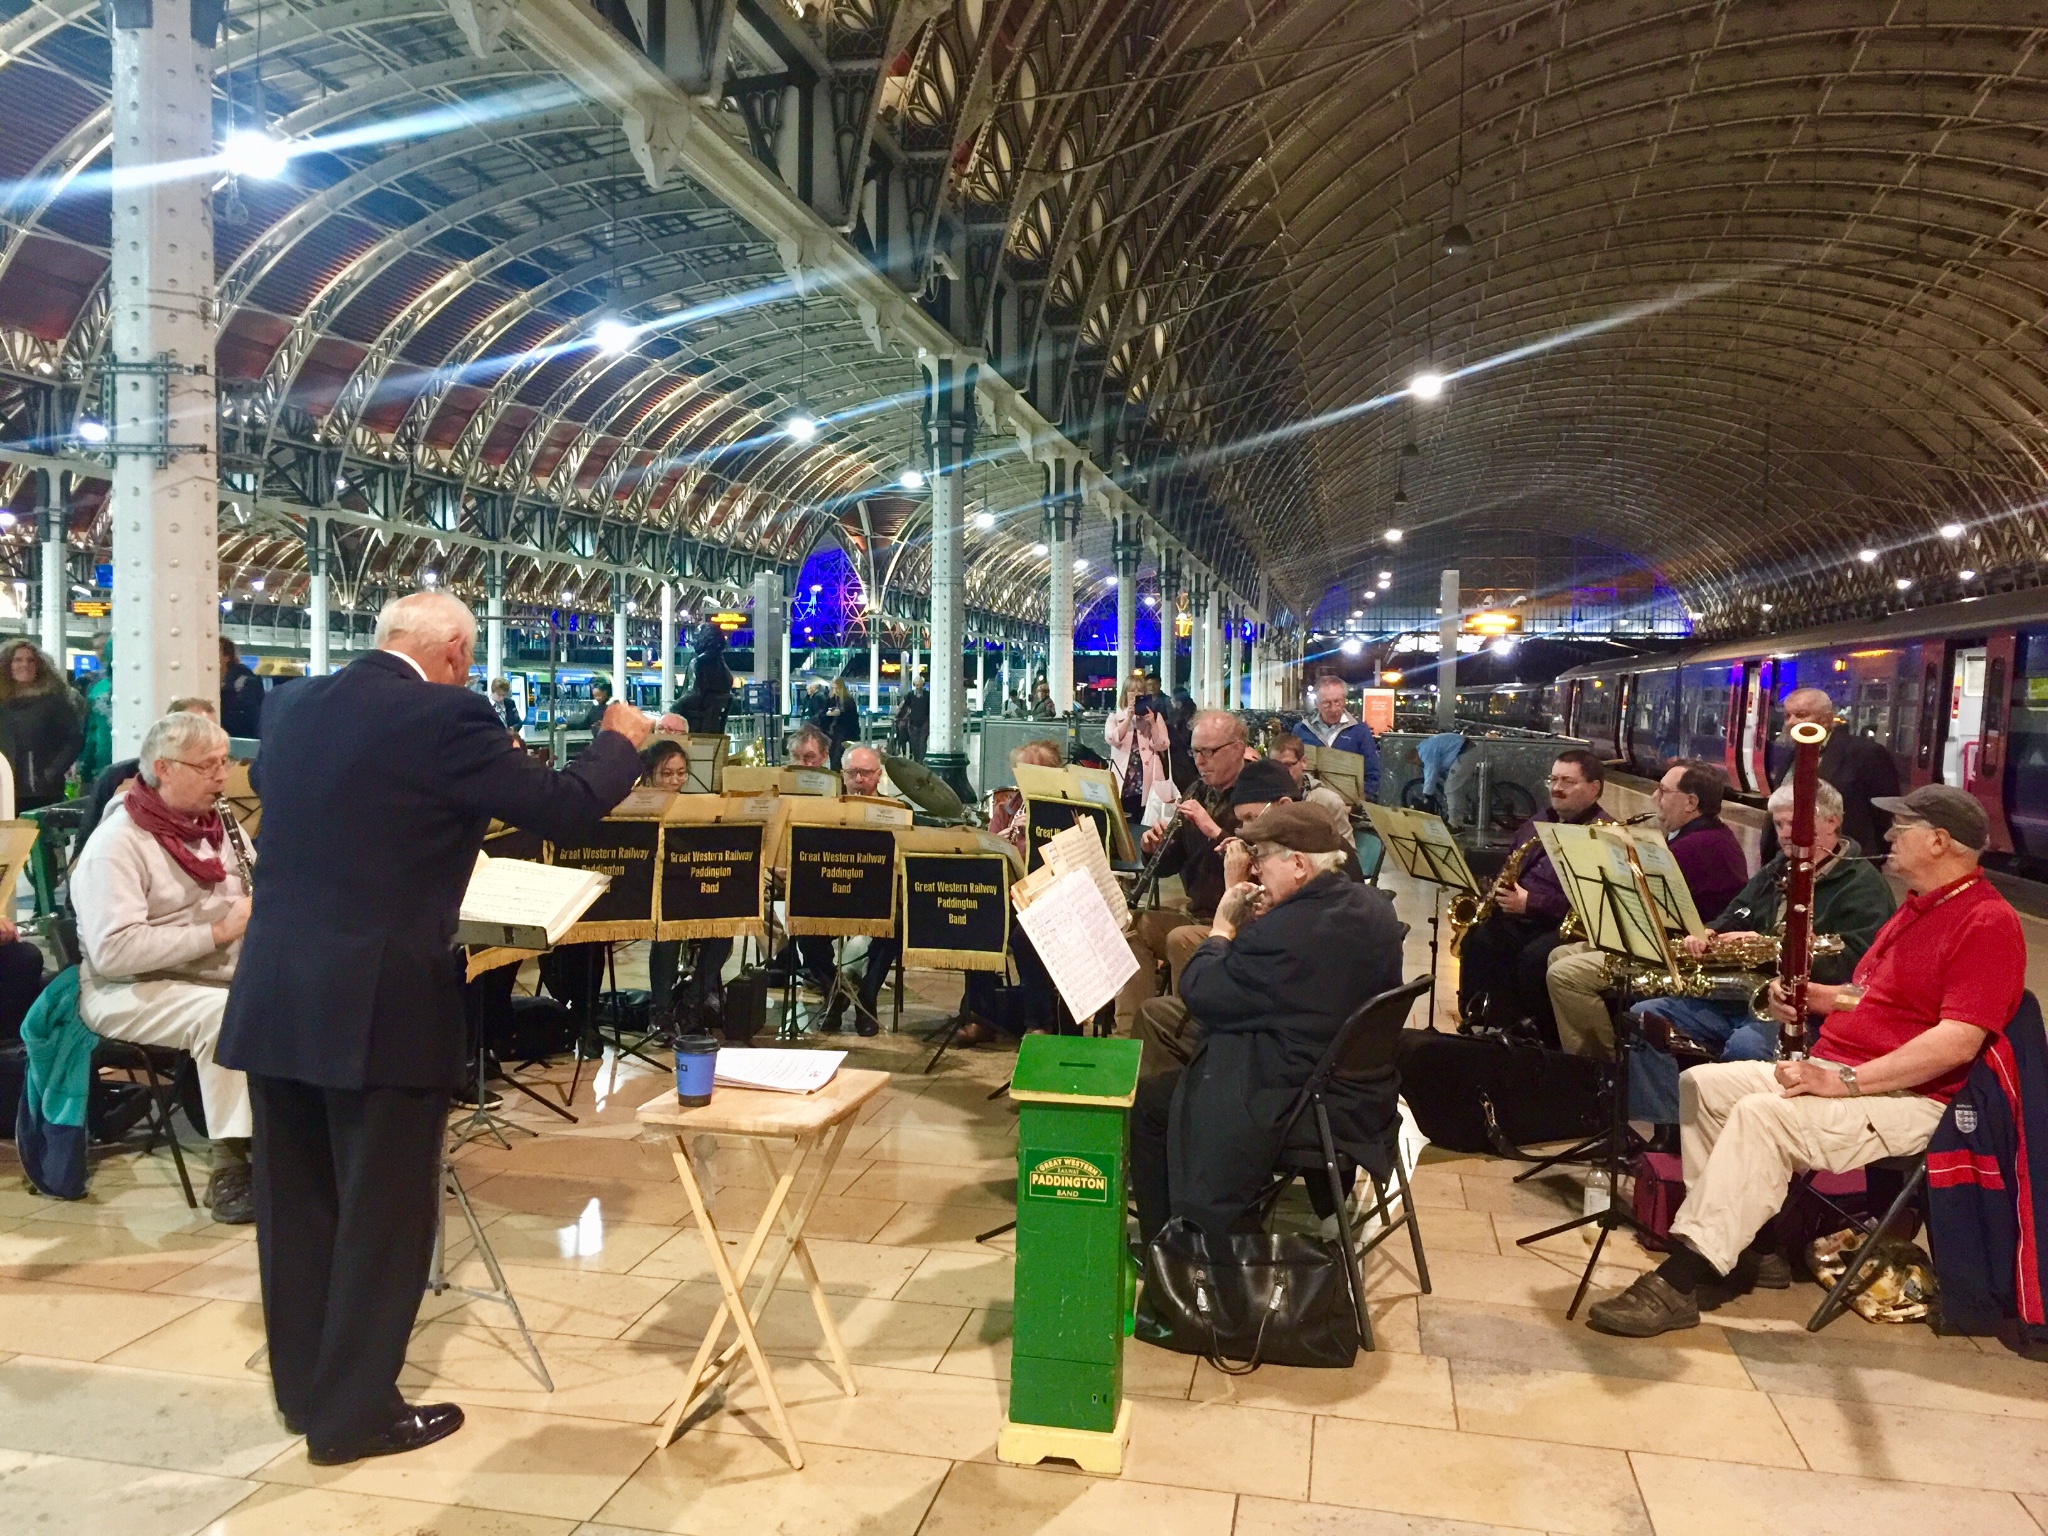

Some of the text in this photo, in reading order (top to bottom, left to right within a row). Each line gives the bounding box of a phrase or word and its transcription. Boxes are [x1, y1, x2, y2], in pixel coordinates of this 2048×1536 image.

[1035, 825, 1053, 839] Great
[560, 846, 650, 860] Great Western Railway
[670, 849, 754, 863] Great Western Railway
[799, 850, 887, 865] Great Western Railway
[581, 864, 625, 876] ddington
[690, 865, 732, 879] Paddington
[821, 866, 864, 880] Paddington
[700, 881, 720, 894] Band
[832, 882, 852, 894] Band
[914, 881, 998, 896] Great Western Railway
[937, 896, 978, 910] Paddington
[948, 913, 967, 925] Band
[1039, 1158, 1099, 1176] GREAT WESTERN
[1057, 1167, 1080, 1175] RAILWAY
[1032, 1173, 1105, 1190] PADDINGTON
[1056, 1189, 1079, 1197] BAND
